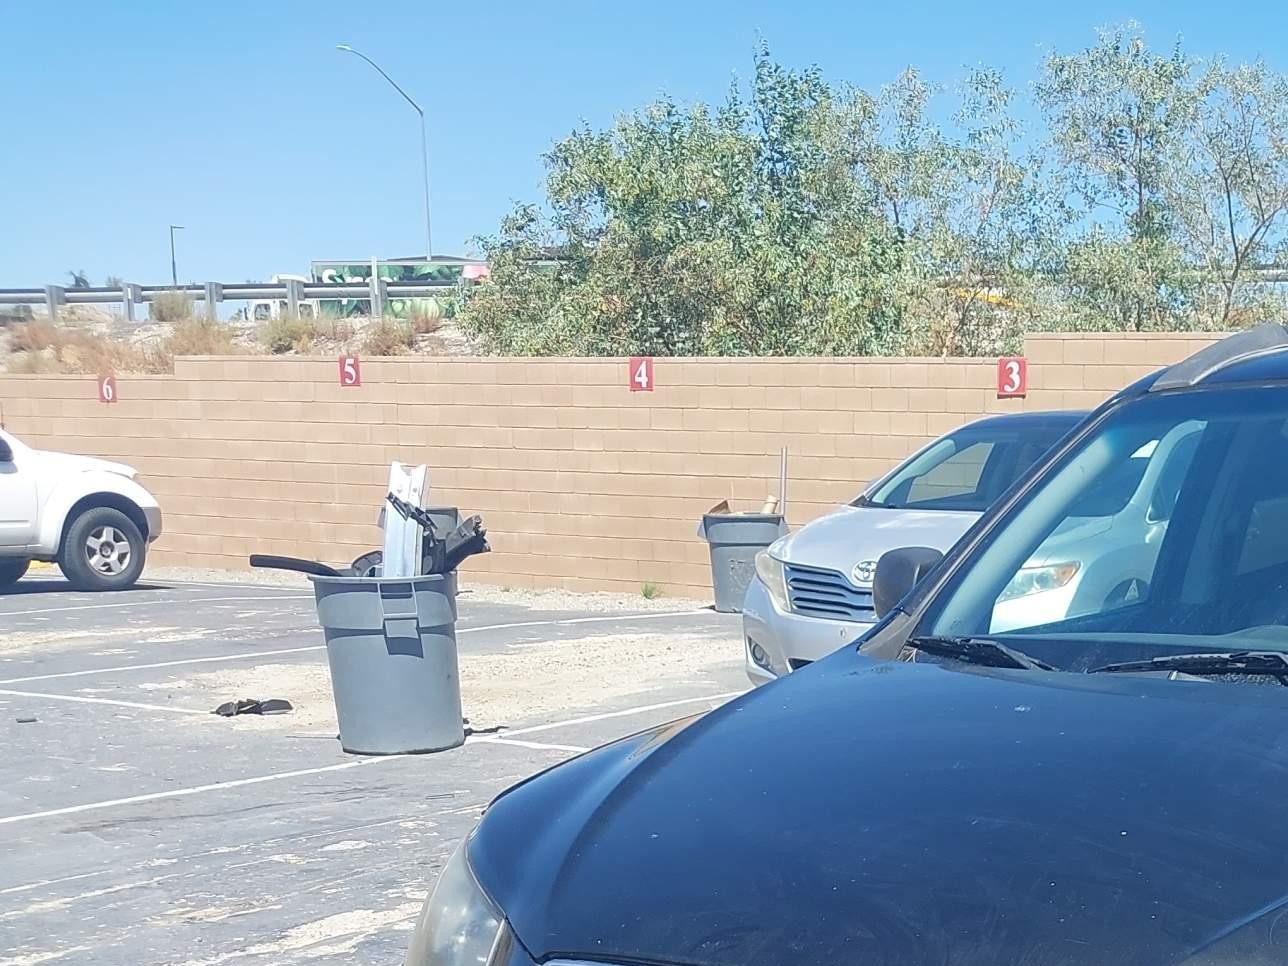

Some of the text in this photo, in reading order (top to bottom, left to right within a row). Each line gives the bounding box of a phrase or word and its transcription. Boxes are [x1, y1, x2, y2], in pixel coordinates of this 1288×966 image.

[343, 358, 356, 384] 5
[634, 360, 649, 388] 4
[1003, 360, 1021, 393] 3
[102, 376, 113, 400] 6
